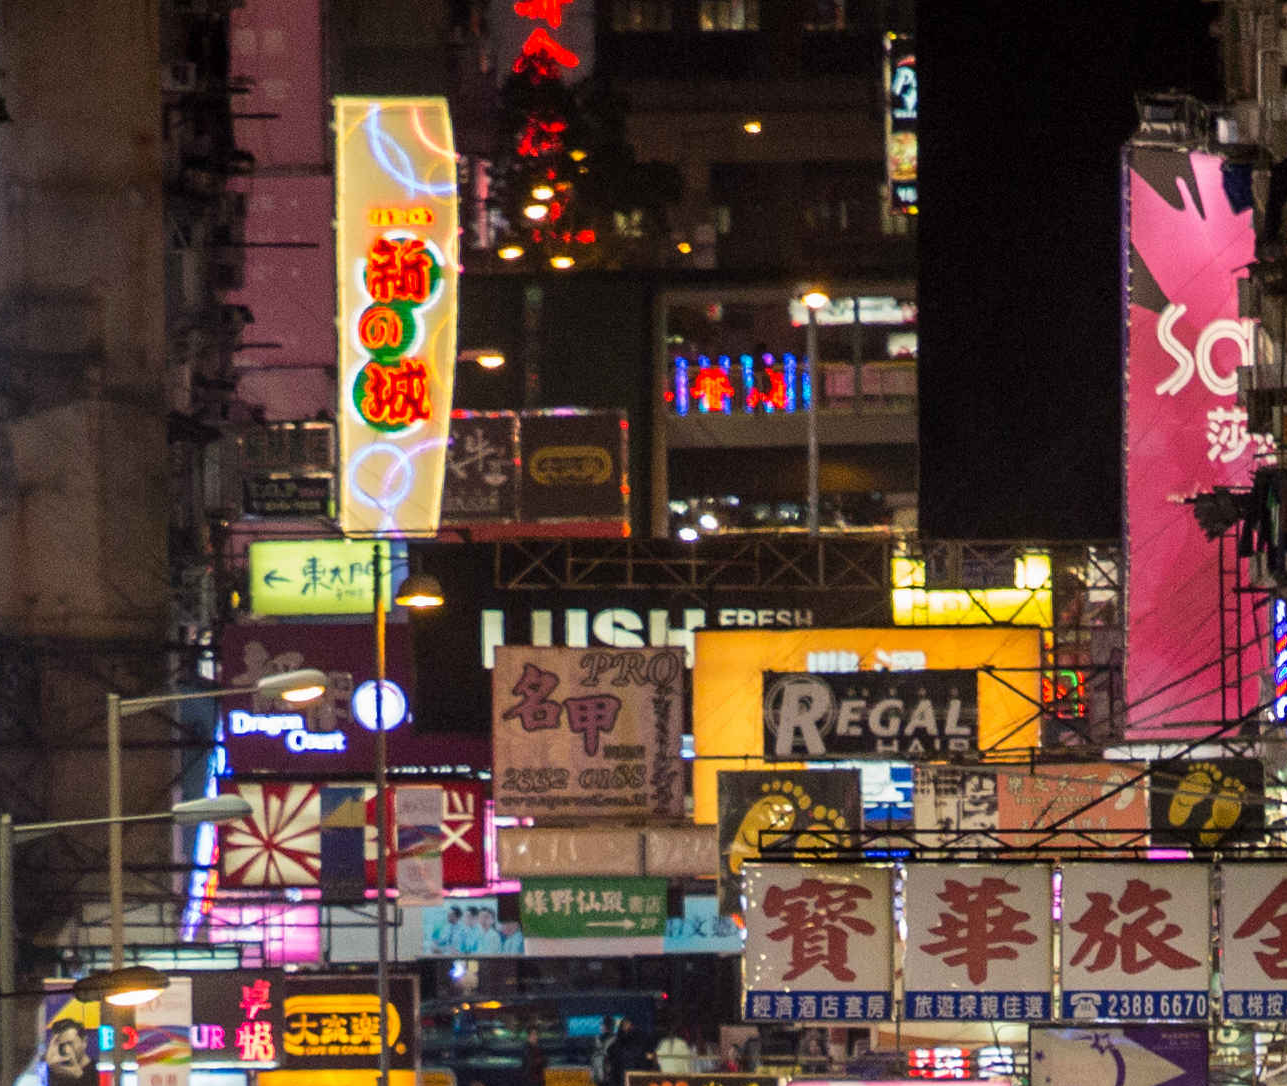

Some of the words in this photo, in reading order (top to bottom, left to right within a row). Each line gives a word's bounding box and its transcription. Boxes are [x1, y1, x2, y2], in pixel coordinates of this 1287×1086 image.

[501, 662, 622, 757] 名甲
[1107, 996, 1154, 1018] 2388
[1160, 996, 1207, 1018] 6670
